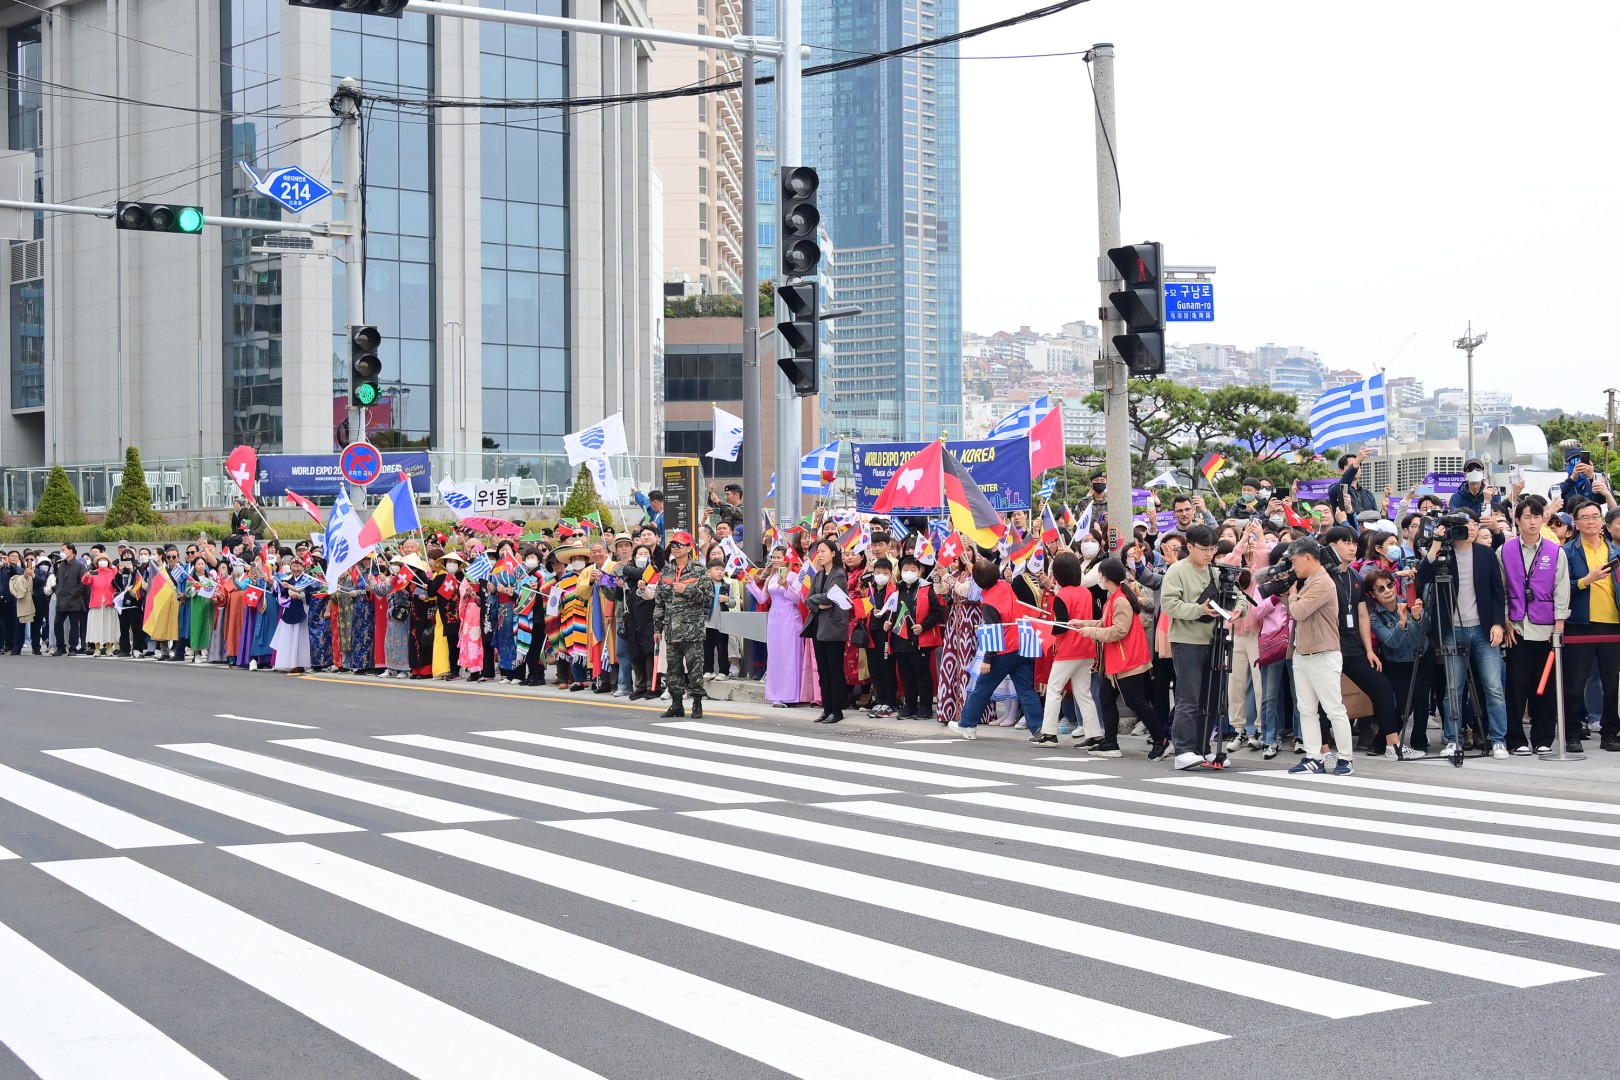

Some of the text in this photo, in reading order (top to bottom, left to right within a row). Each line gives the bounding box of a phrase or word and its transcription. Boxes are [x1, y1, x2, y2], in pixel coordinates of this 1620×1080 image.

[280, 182, 311, 201] 214
[1180, 285, 1211, 299] 구남로
[1176, 300, 1211, 310] Gunam-ro
[865, 451, 882, 466] WORLD
[882, 451, 899, 467] EXPO
[959, 447, 996, 464] KOREA
[291, 466, 315, 476] WORLD
[315, 466, 333, 475] EXPO
[380, 464, 401, 474] OREA
[872, 467, 886, 477] Please
[476, 488, 508, 507] 우1동
